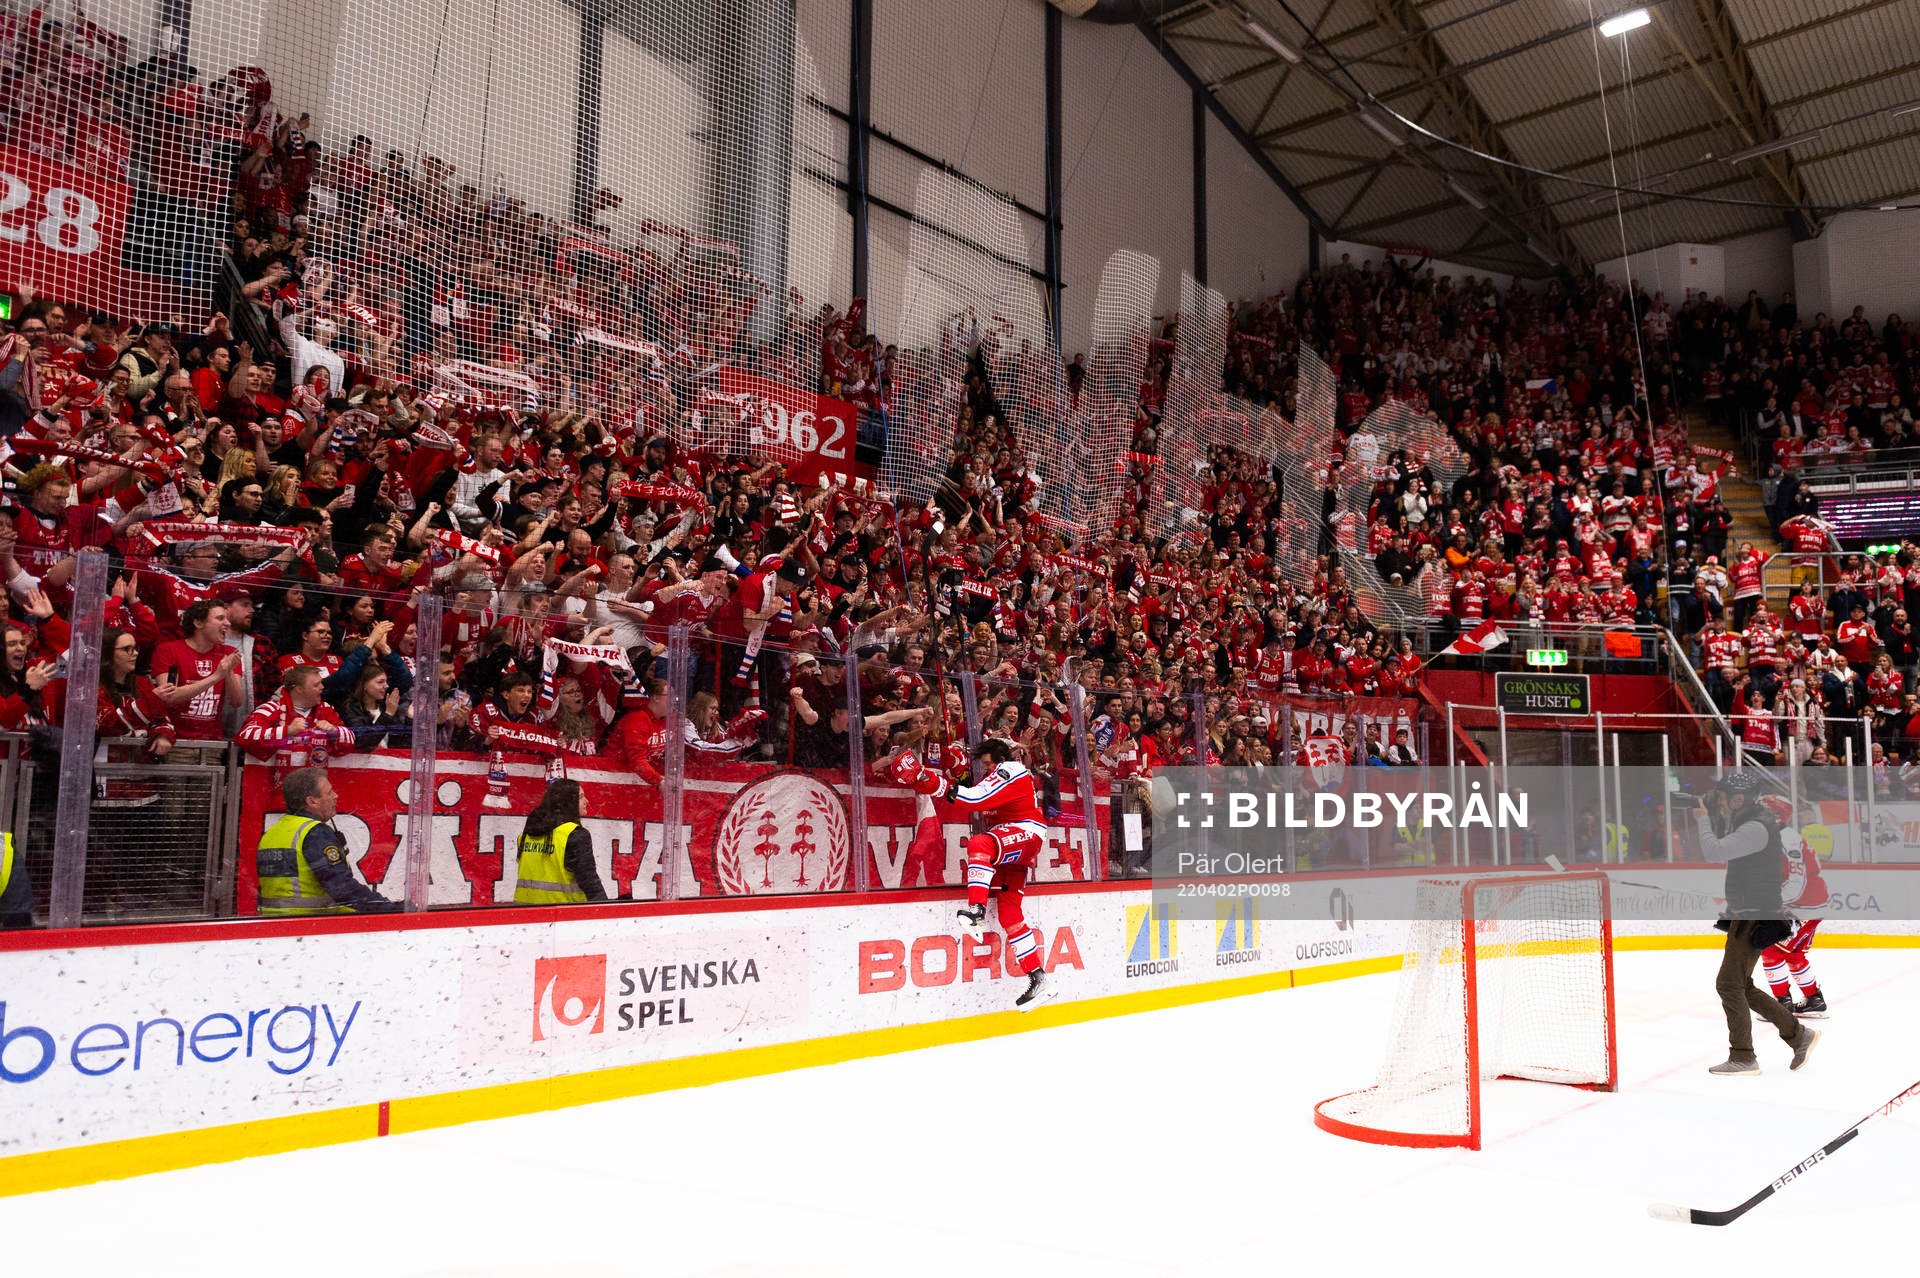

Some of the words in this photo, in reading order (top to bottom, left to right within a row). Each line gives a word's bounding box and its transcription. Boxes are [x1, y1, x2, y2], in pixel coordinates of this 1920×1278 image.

[0, 171, 100, 254] 28
[736, 393, 846, 459] 962
[962, 579, 983, 594] IMRÅ
[1504, 680, 1581, 696] GRÖNSAKS
[1525, 695, 1571, 708] HUSET
[1789, 861, 1804, 876] 85
[1830, 893, 1882, 913] SCA
[1216, 951, 1262, 967] EUROCON
[1296, 938, 1353, 961] OLOFSSON
[619, 958, 761, 997] SVENSKA
[1126, 959, 1179, 978] EUROCON
[618, 998, 694, 1032] SPEL
[1771, 1149, 1827, 1192] BAUER
